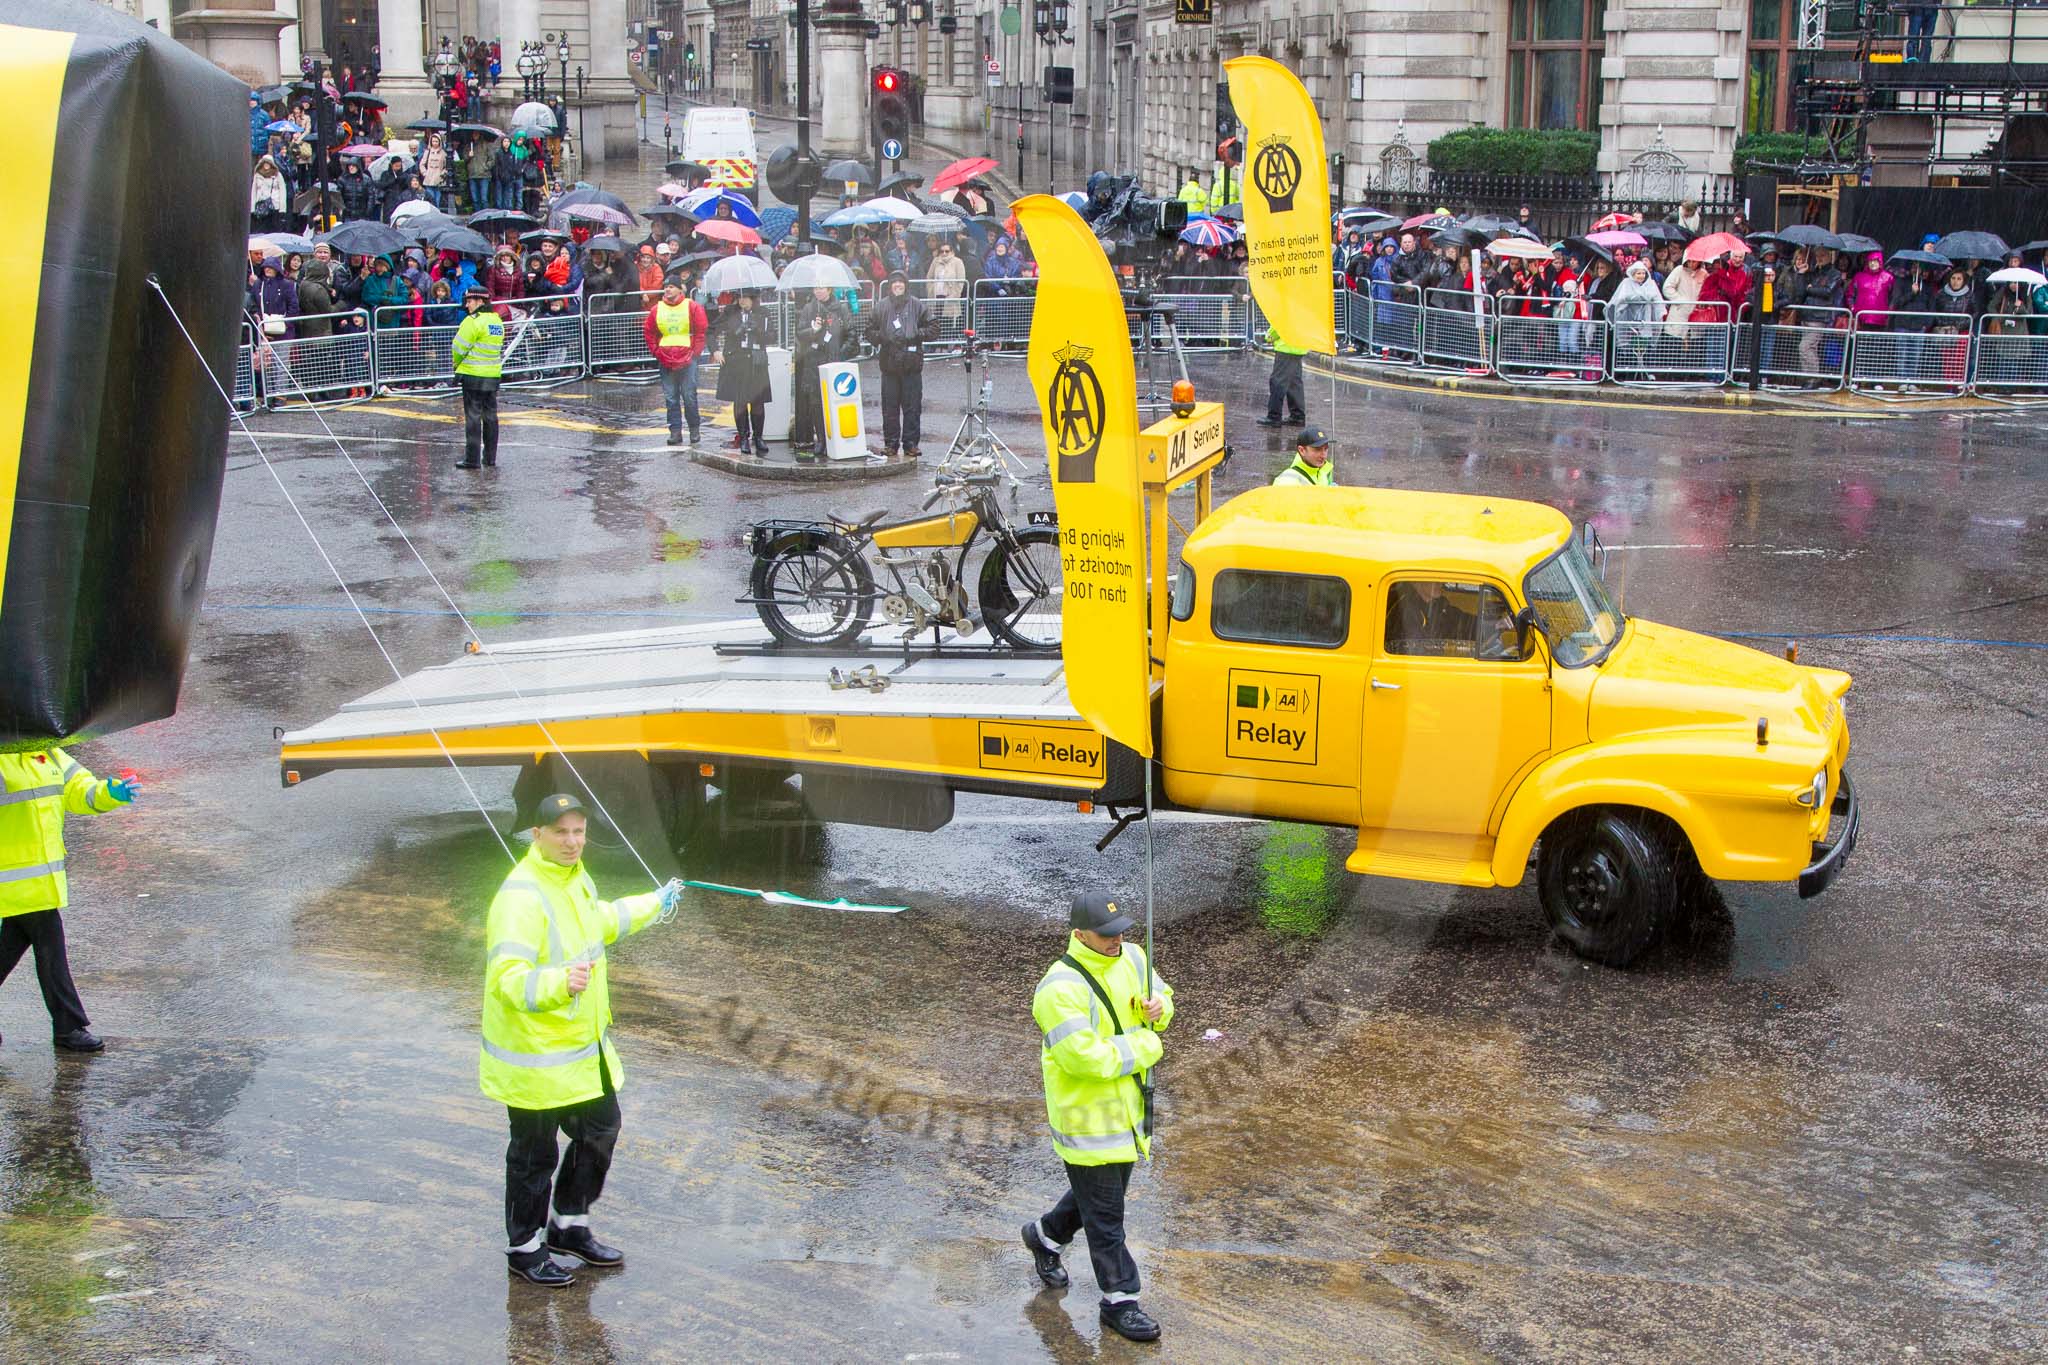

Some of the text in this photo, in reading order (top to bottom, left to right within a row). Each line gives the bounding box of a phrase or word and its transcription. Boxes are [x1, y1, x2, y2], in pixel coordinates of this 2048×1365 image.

[1170, 421, 1220, 472] AA Service
[1278, 694, 1296, 707] AA
[1236, 719, 1307, 752] Relay
[1015, 741, 1100, 768] AA Relay
